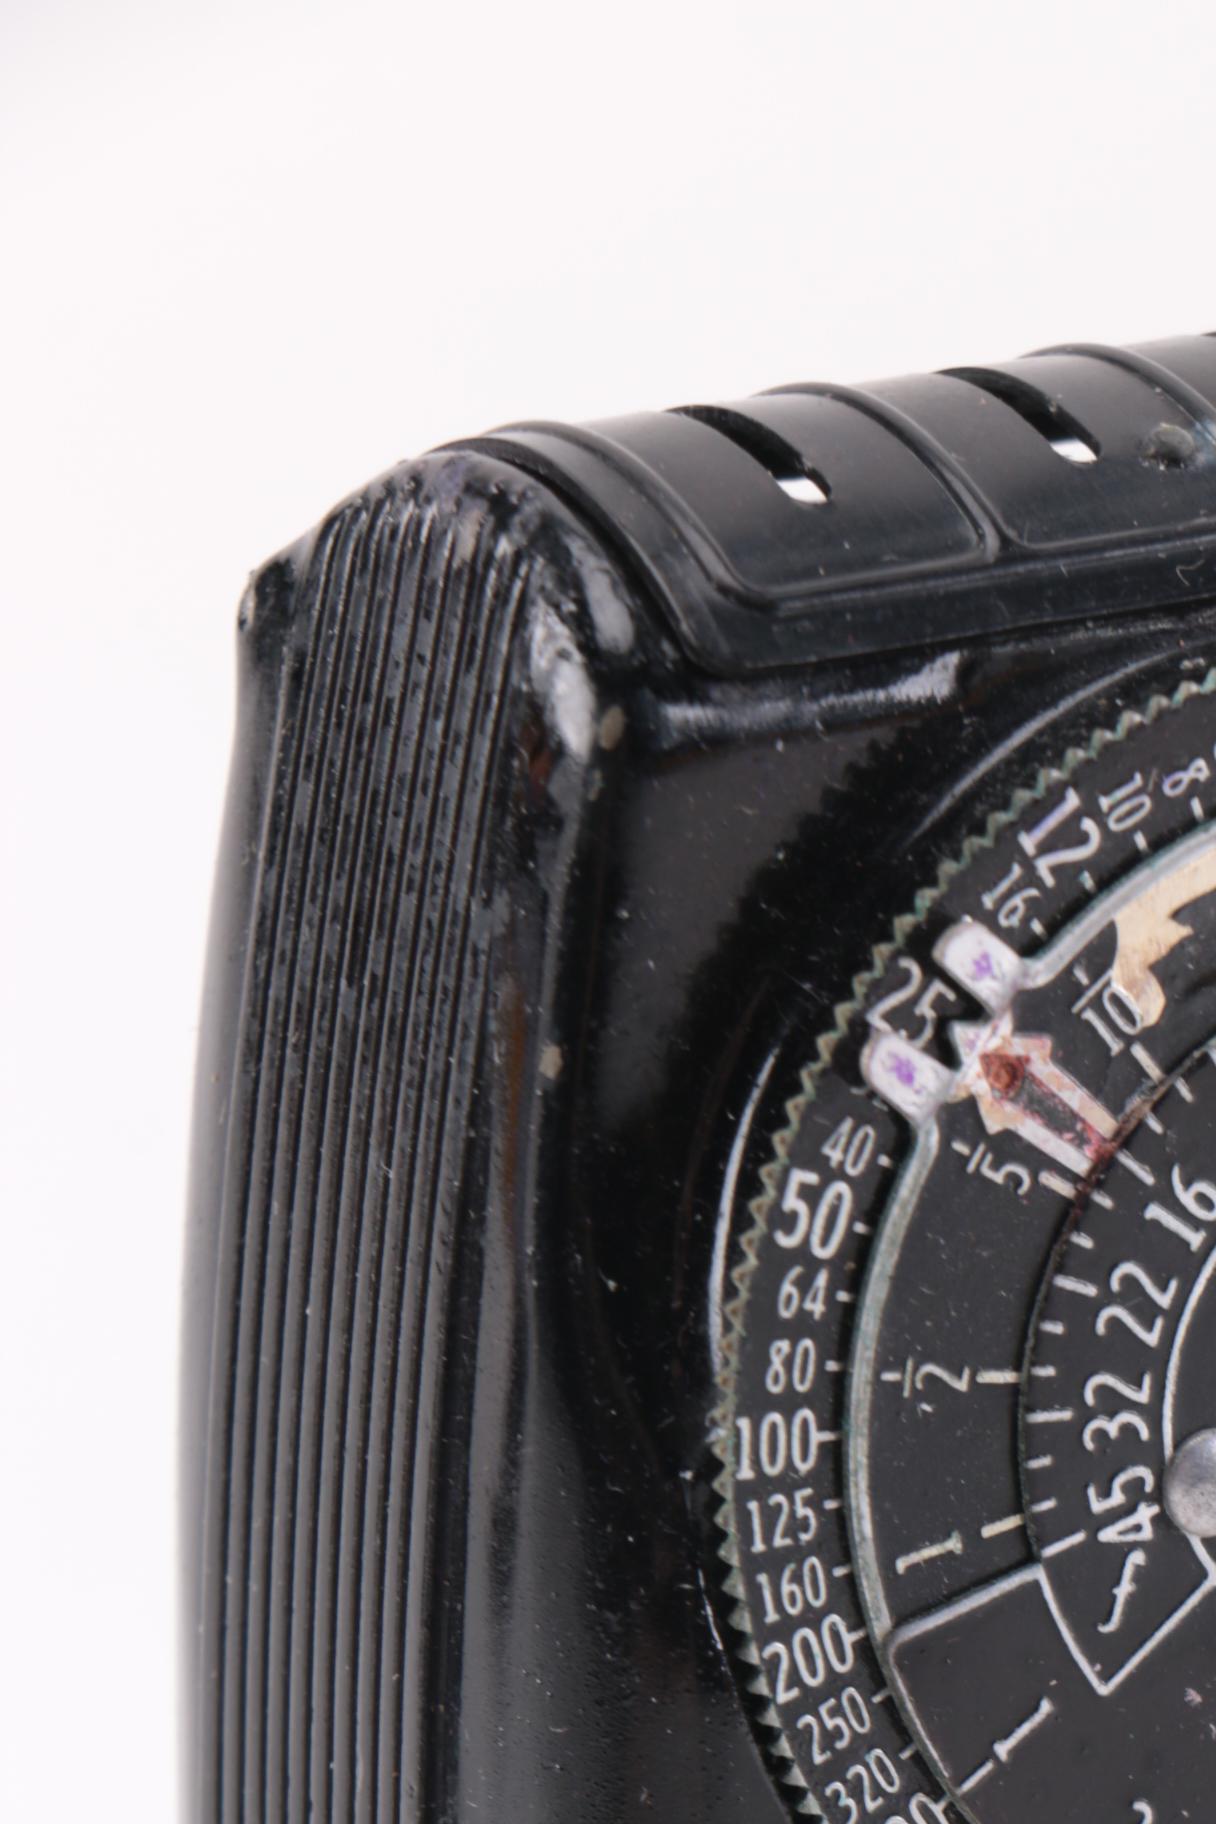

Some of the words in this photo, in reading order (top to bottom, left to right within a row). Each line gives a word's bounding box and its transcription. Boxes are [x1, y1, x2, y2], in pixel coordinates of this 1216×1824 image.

[1019, 787, 1100, 888] 12
[1099, 772, 1152, 832] 10
[982, 863, 1040, 927] 16
[821, 1117, 876, 1177] 40
[773, 1168, 853, 1260] 50
[778, 1266, 829, 1321] 64
[1095, 1261, 1178, 1348] 22
[765, 1338, 816, 1393] 80
[735, 1408, 818, 1480] 100
[1083, 1371, 1152, 1451] 32
[747, 1488, 817, 1553] 125
[1086, 1465, 1161, 1543] 45
[756, 1556, 827, 1624] 160
[762, 1613, 854, 1705] 200
[797, 1686, 871, 1765] 250
